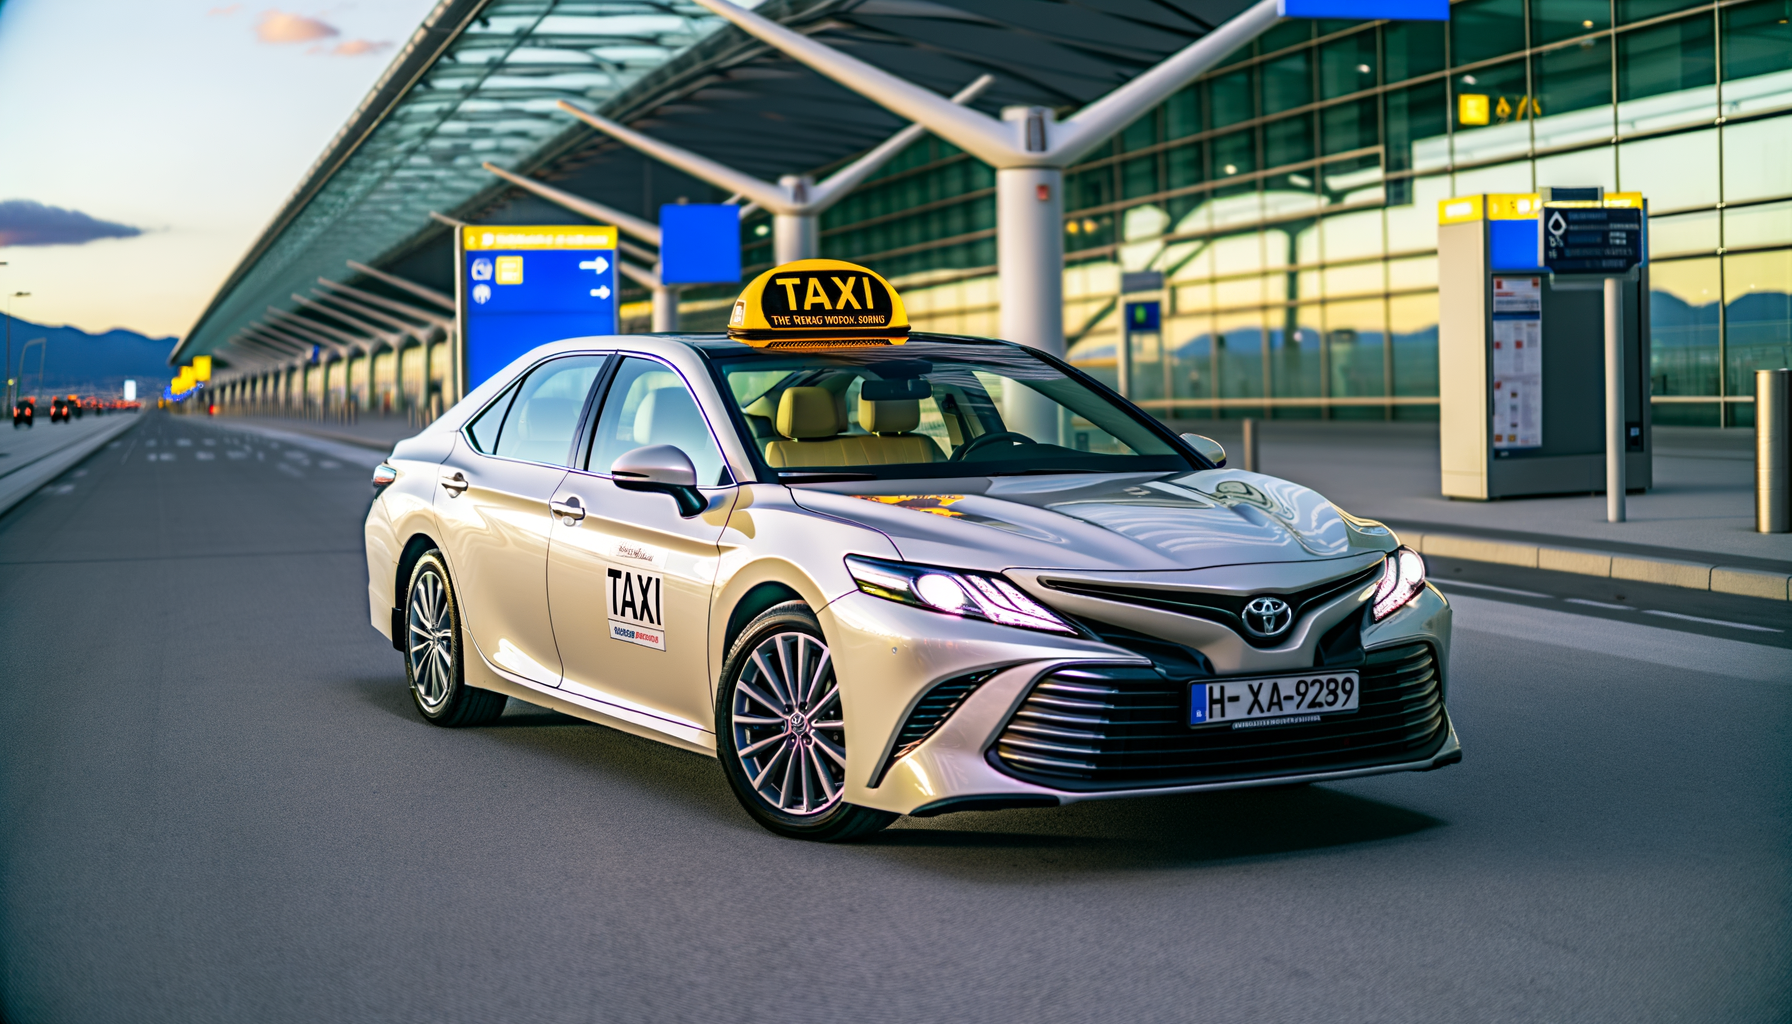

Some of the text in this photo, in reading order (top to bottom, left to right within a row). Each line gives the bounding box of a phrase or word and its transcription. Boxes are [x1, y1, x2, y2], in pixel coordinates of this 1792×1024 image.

[775, 276, 875, 311] TAXI
[771, 315, 791, 326] THE
[607, 567, 662, 626] TAXI
